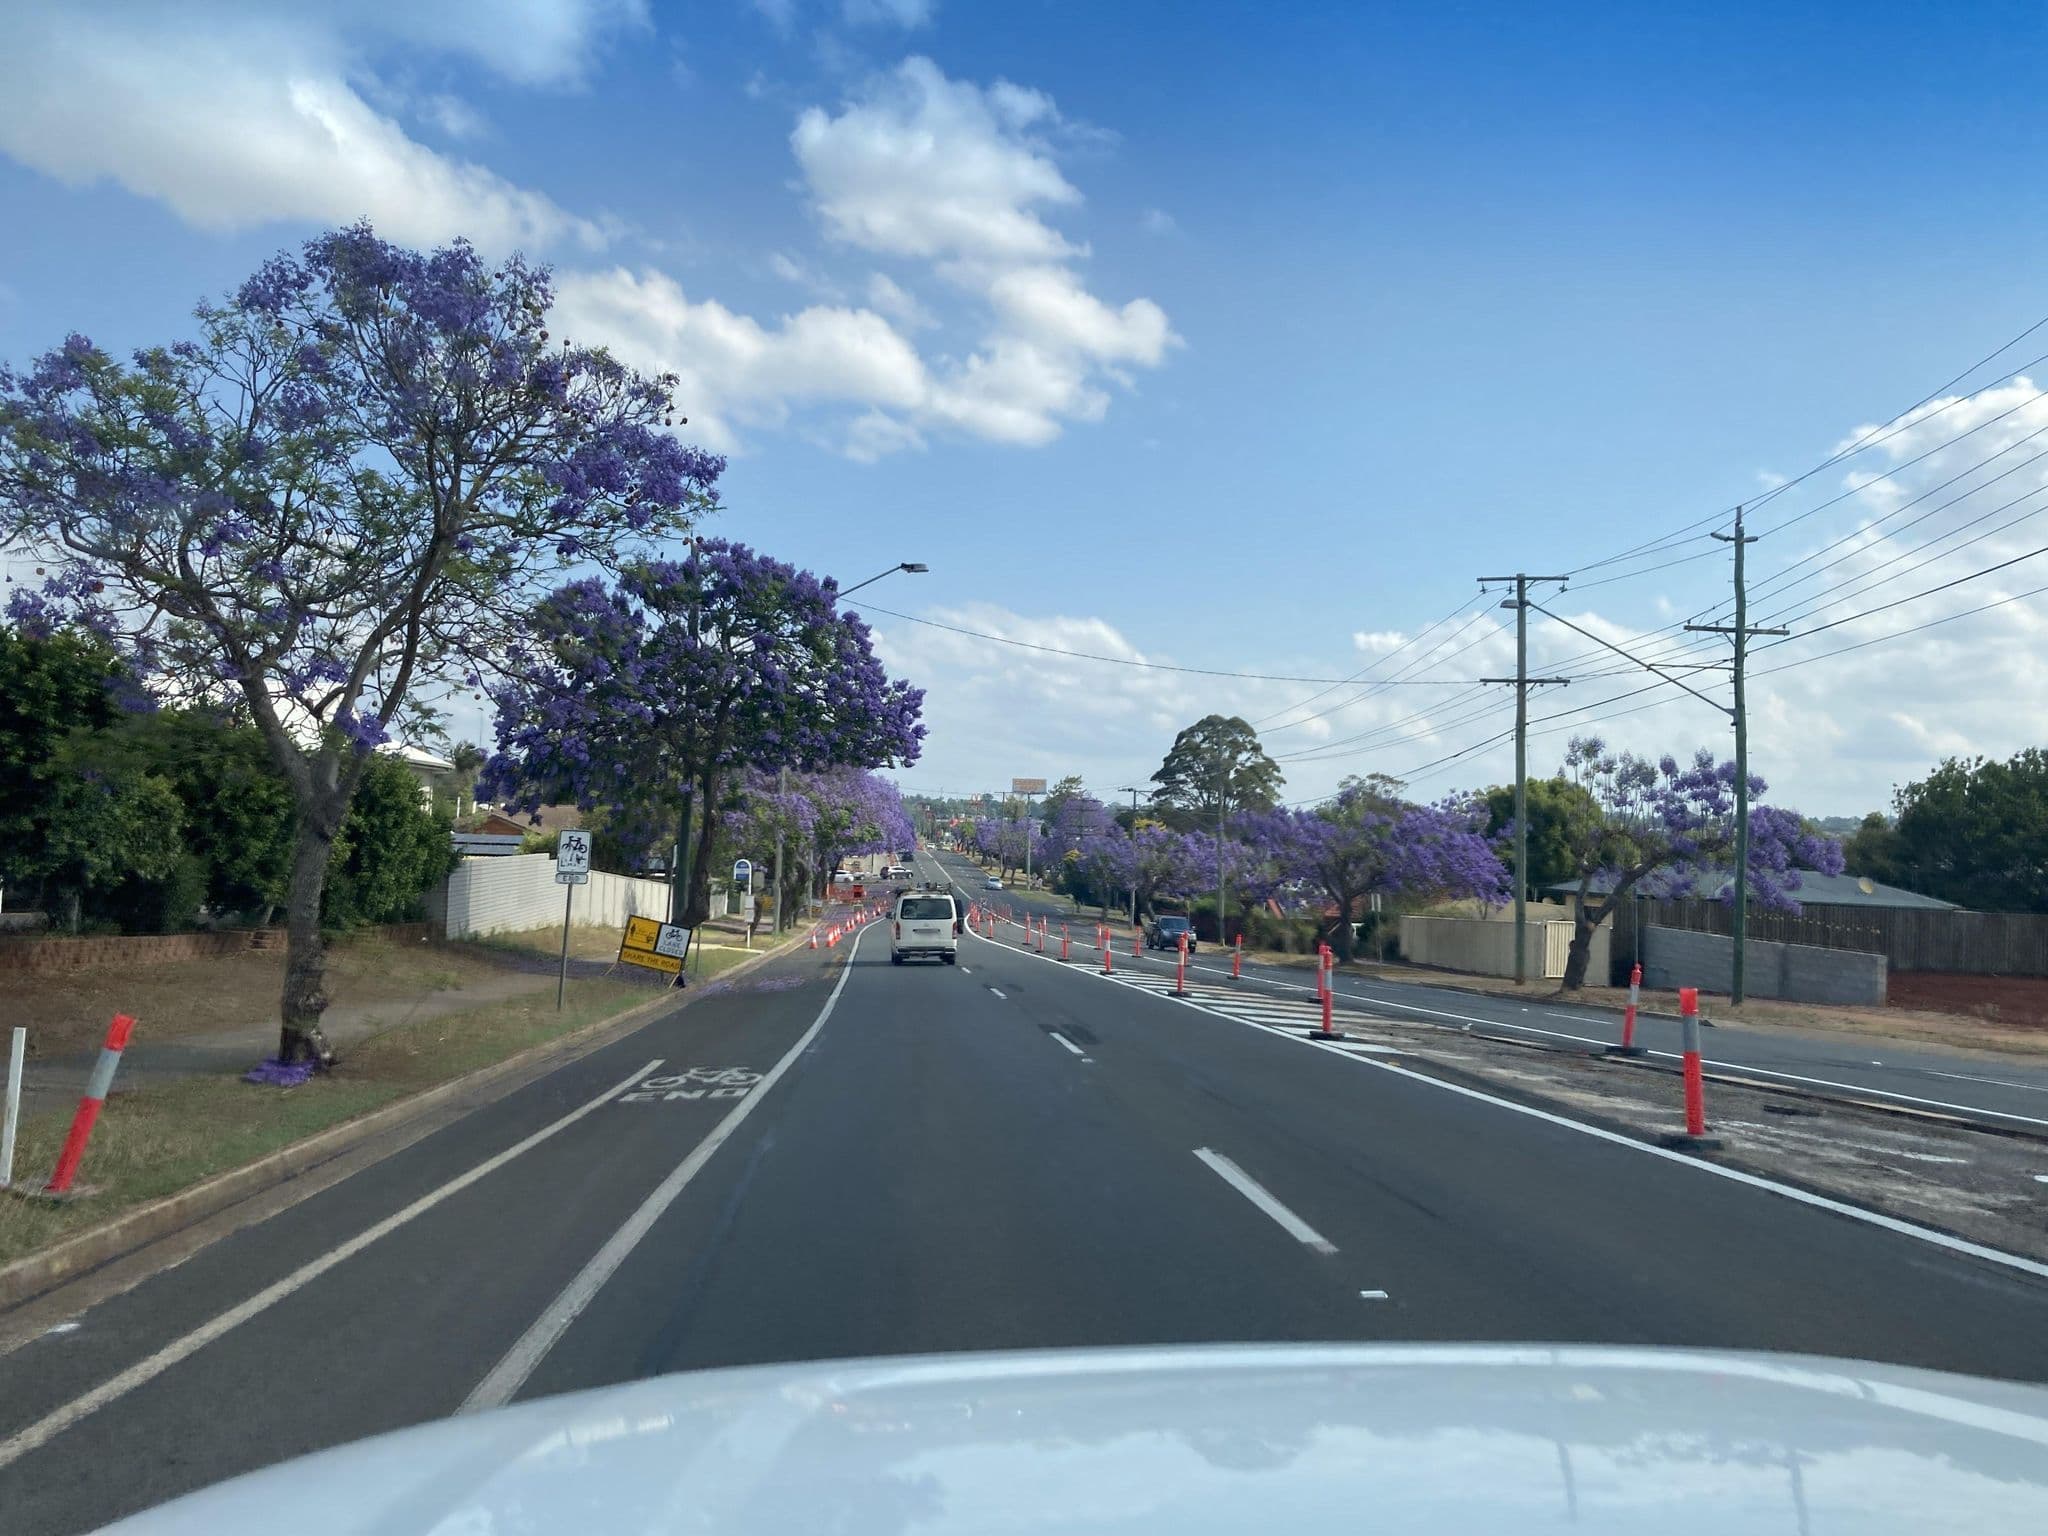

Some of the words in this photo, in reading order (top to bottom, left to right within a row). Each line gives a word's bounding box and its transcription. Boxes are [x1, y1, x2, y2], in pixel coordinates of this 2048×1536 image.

[663, 939, 682, 948] LANE
[658, 945, 684, 956] CLOSED
[623, 951, 644, 962] SHARE
[647, 955, 659, 965] THE
[660, 959, 680, 970] ROAD
[618, 1087, 751, 1102] END
